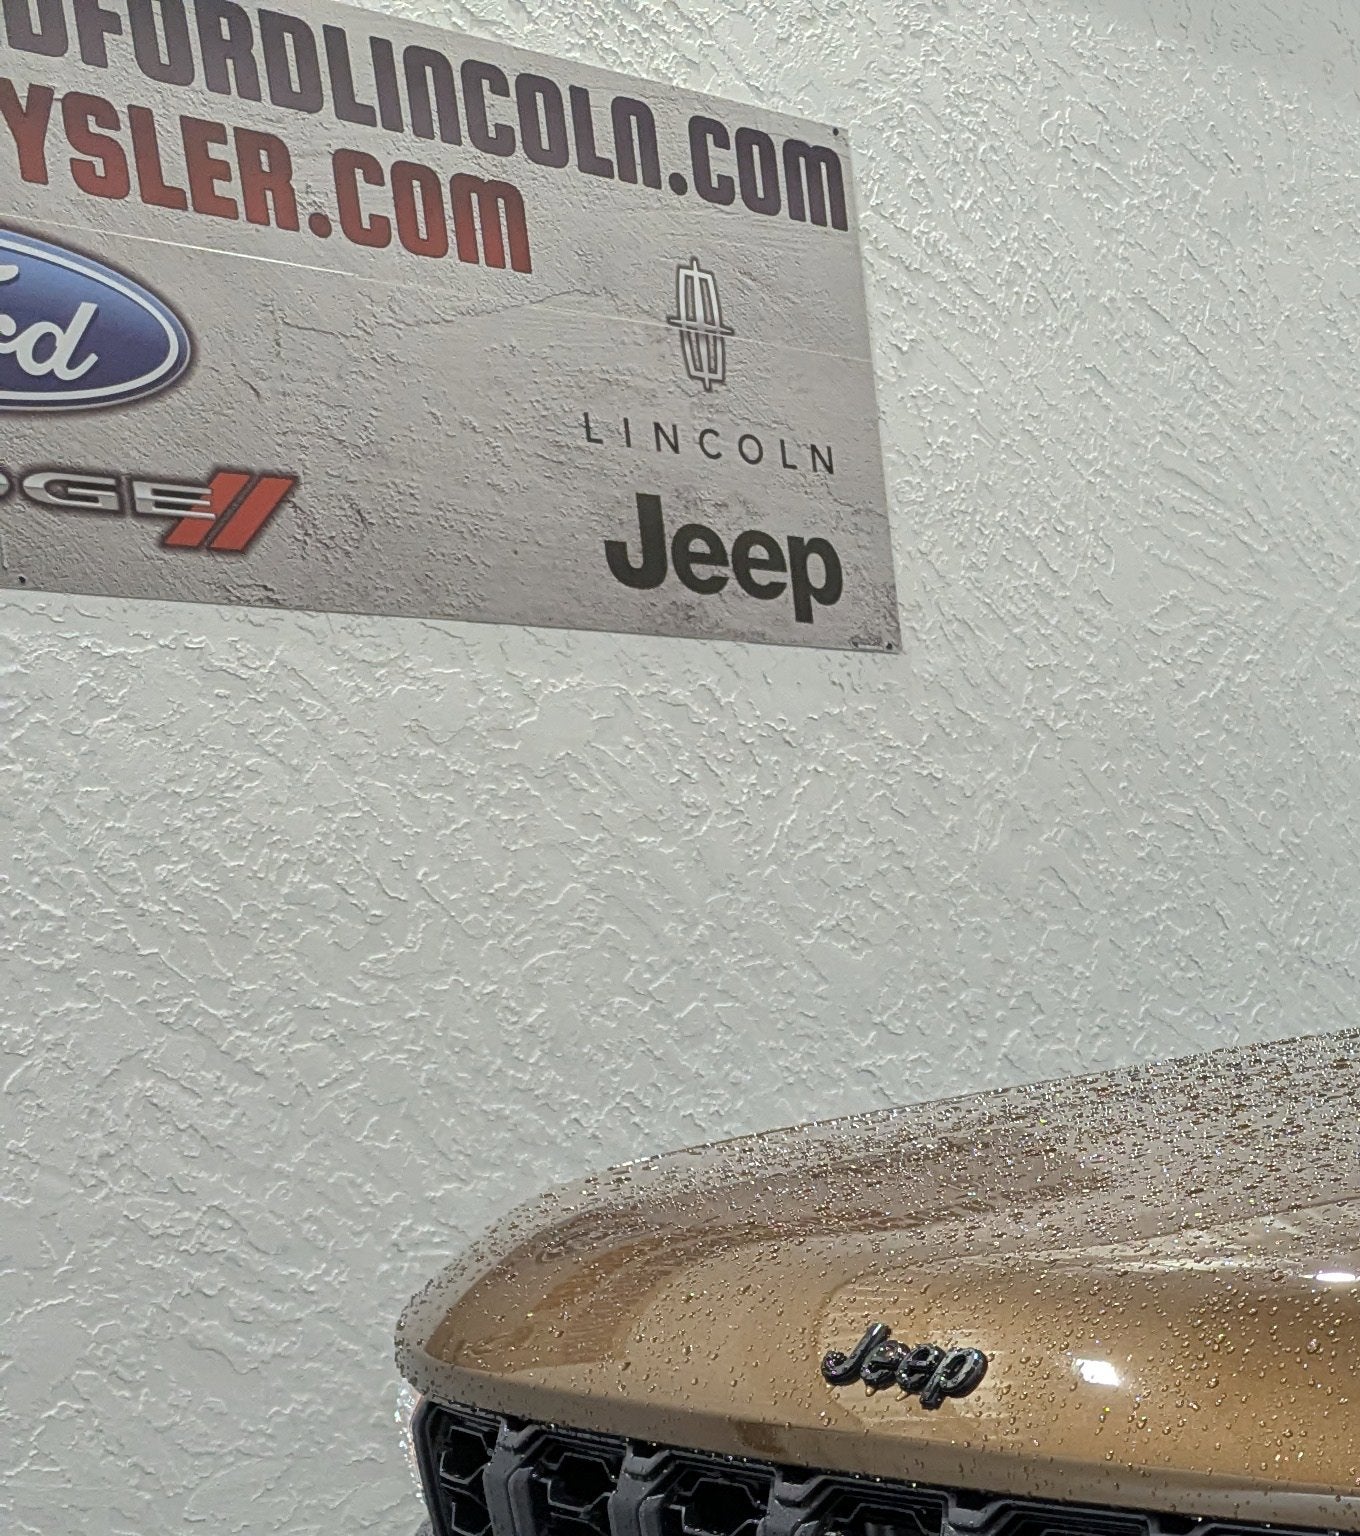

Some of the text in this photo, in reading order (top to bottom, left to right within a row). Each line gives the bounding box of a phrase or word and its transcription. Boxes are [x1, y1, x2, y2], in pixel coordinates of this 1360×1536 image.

[583, 411, 835, 475] LINCOLN
[603, 492, 844, 624] Jeep
[820, 1322, 989, 1411] Jeep
